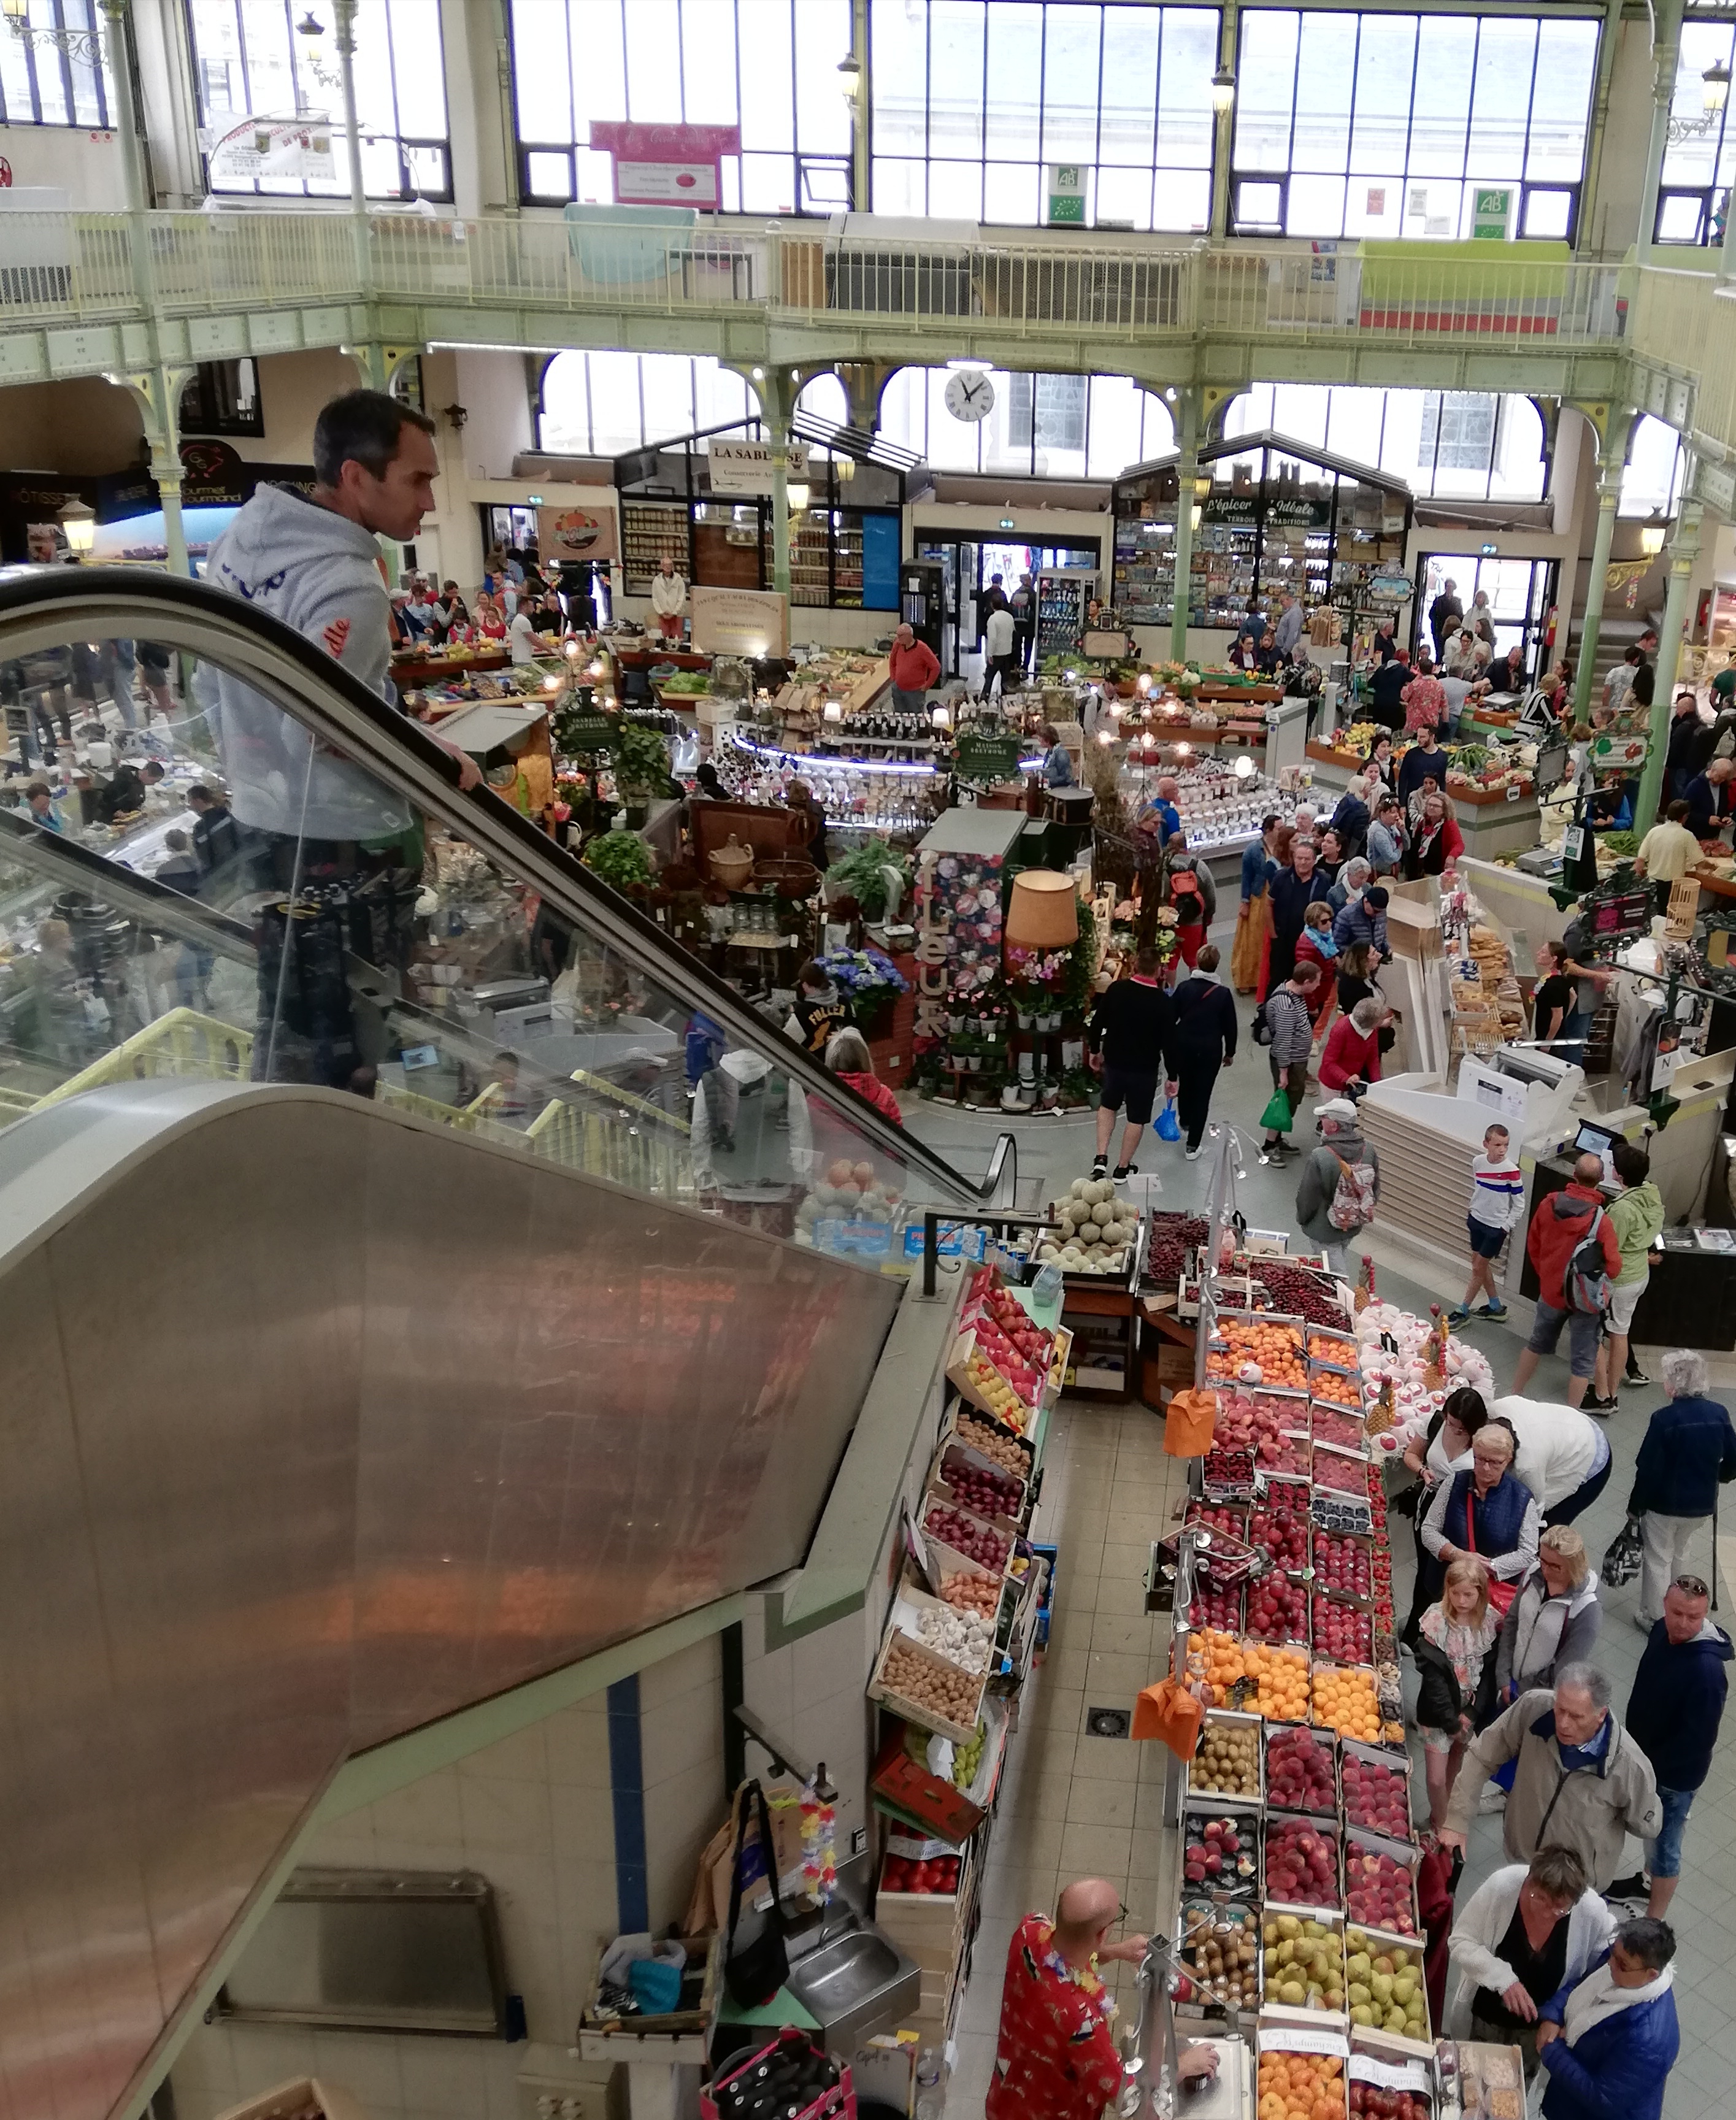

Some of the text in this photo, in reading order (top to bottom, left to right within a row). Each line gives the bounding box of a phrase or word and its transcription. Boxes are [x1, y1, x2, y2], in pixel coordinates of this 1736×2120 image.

[1059, 172, 1075, 185] AB
[1480, 195, 1502, 212] AB
[714, 447, 802, 463] LA SABLSE
